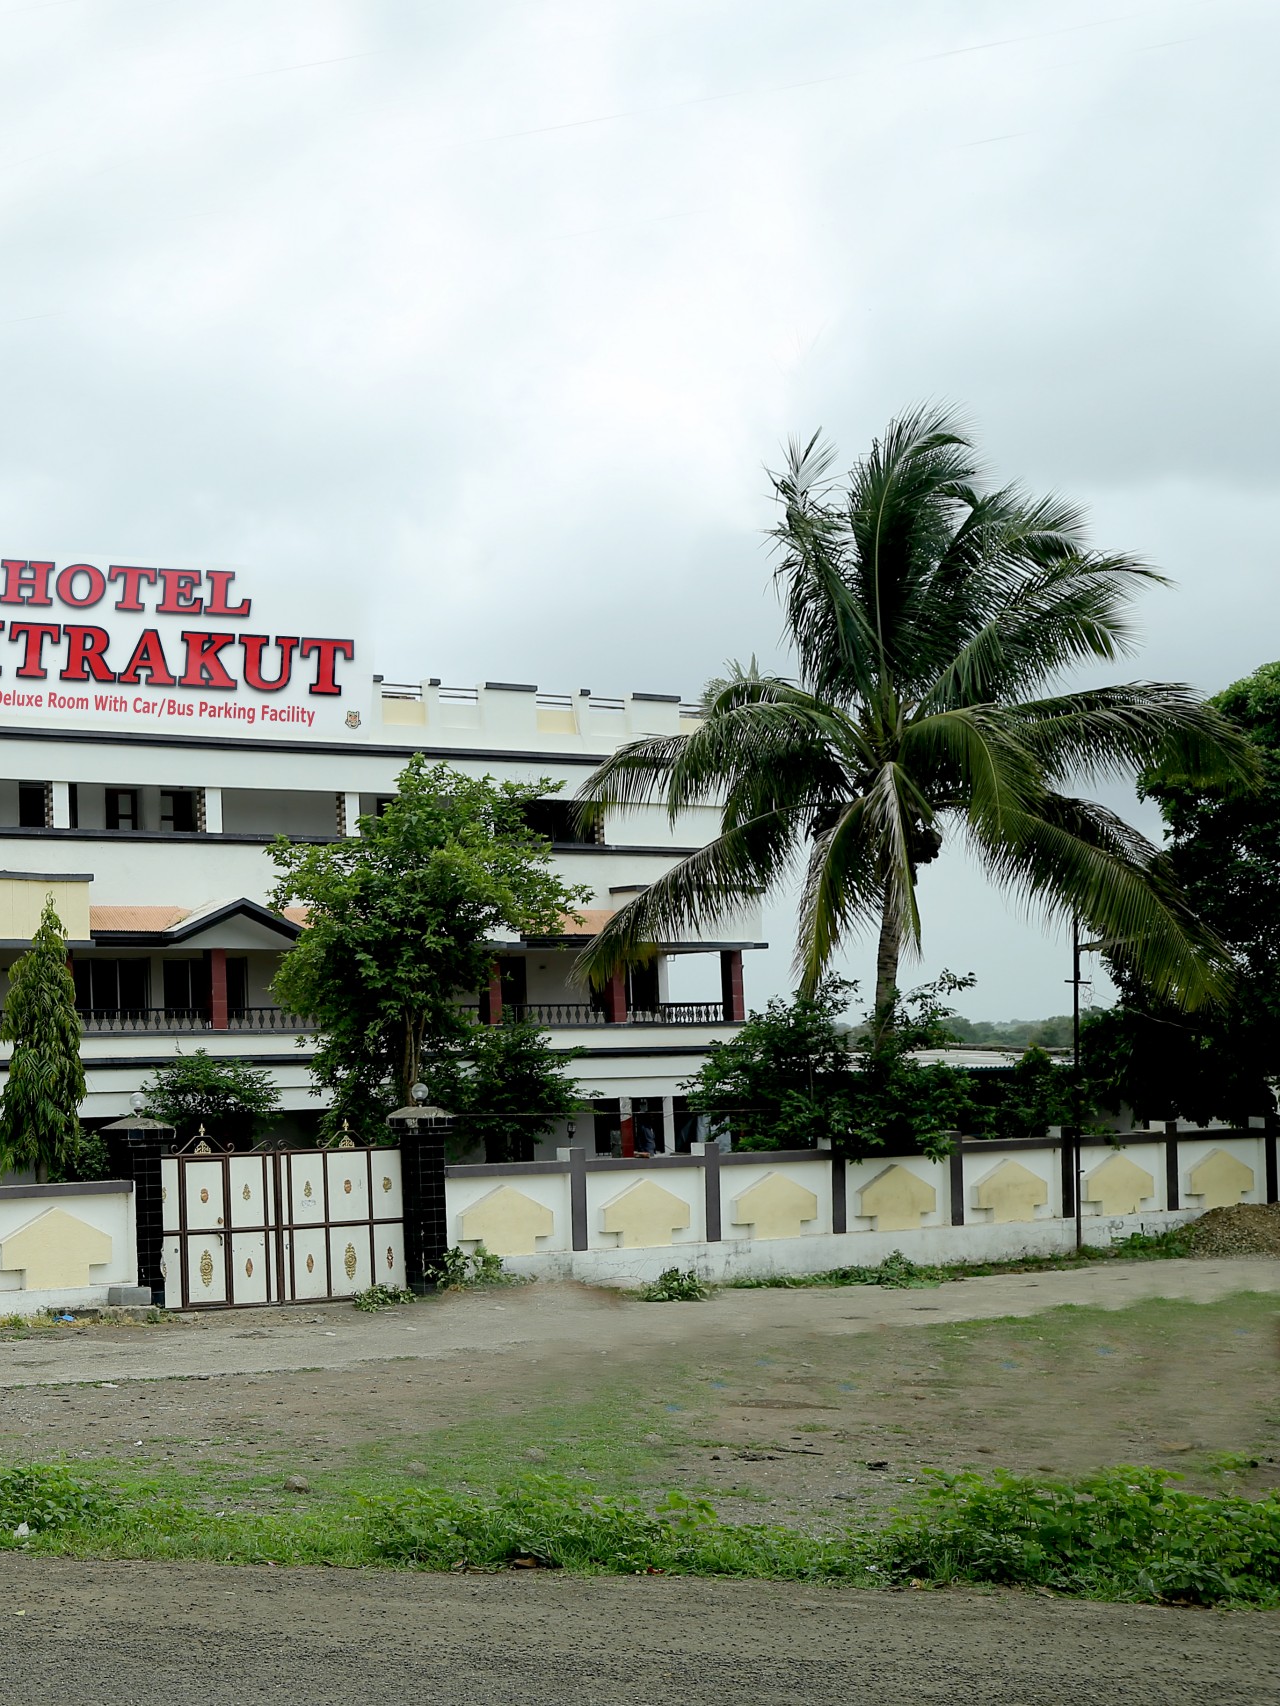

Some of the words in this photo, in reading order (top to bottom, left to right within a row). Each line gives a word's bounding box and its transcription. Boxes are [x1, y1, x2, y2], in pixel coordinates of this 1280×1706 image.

[0, 559, 252, 617] HOTEL
[47, 691, 89, 710] Room
[93, 695, 128, 712] With
[132, 697, 195, 717] Car/Bus
[198, 701, 256, 725] Parking
[261, 704, 315, 727] Facility
